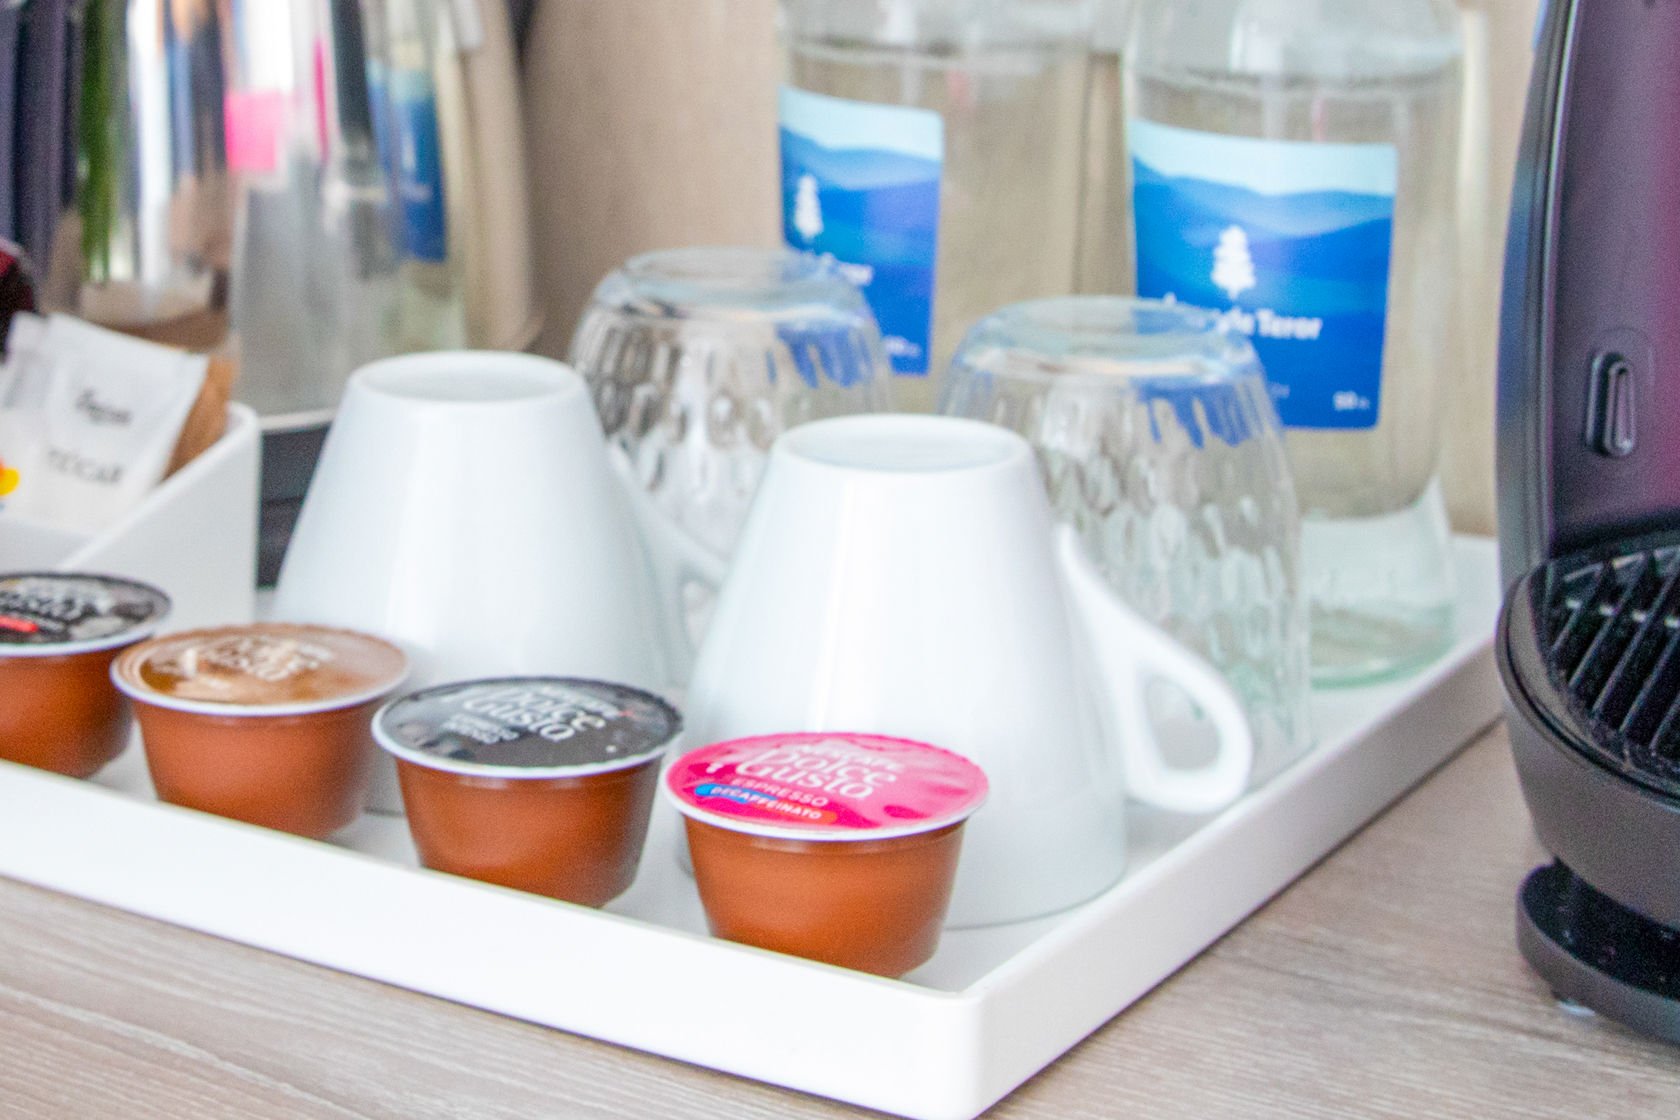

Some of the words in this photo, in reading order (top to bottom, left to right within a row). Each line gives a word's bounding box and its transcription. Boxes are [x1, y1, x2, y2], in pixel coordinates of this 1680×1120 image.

[1257, 308, 1323, 340] Teror
[735, 756, 874, 799] Gusto
[760, 746, 898, 787] Dolce
[710, 786, 823, 820] DECAFFEINATO
[730, 777, 829, 807] ESPRESSO
